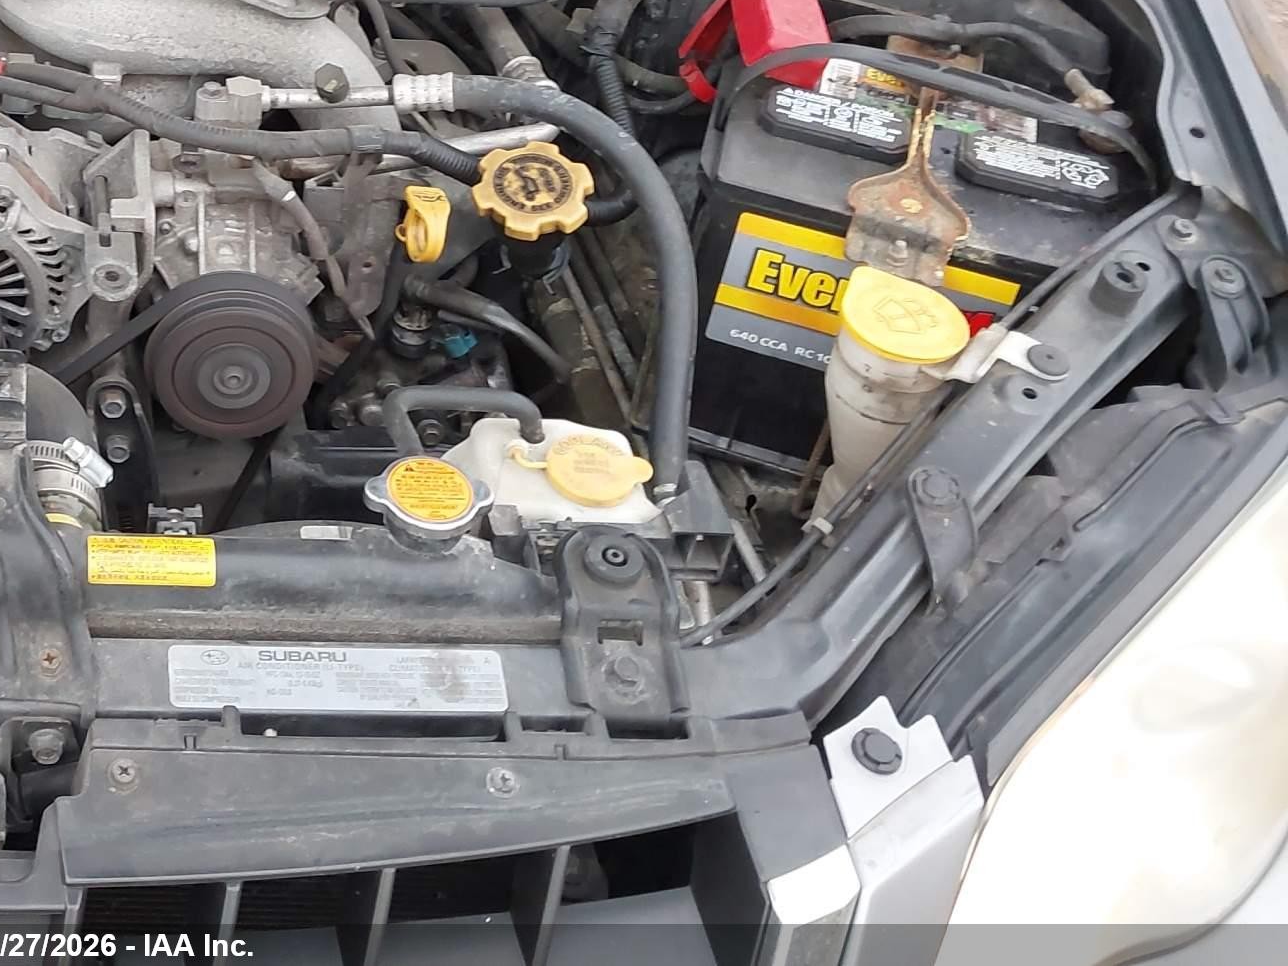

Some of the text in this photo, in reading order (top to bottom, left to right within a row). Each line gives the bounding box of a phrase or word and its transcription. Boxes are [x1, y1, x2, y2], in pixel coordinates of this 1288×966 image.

[729, 329, 758, 343] 640
[759, 337, 788, 352] CCA
[794, 346, 816, 359] RC
[258, 650, 346, 662] SUBARU
